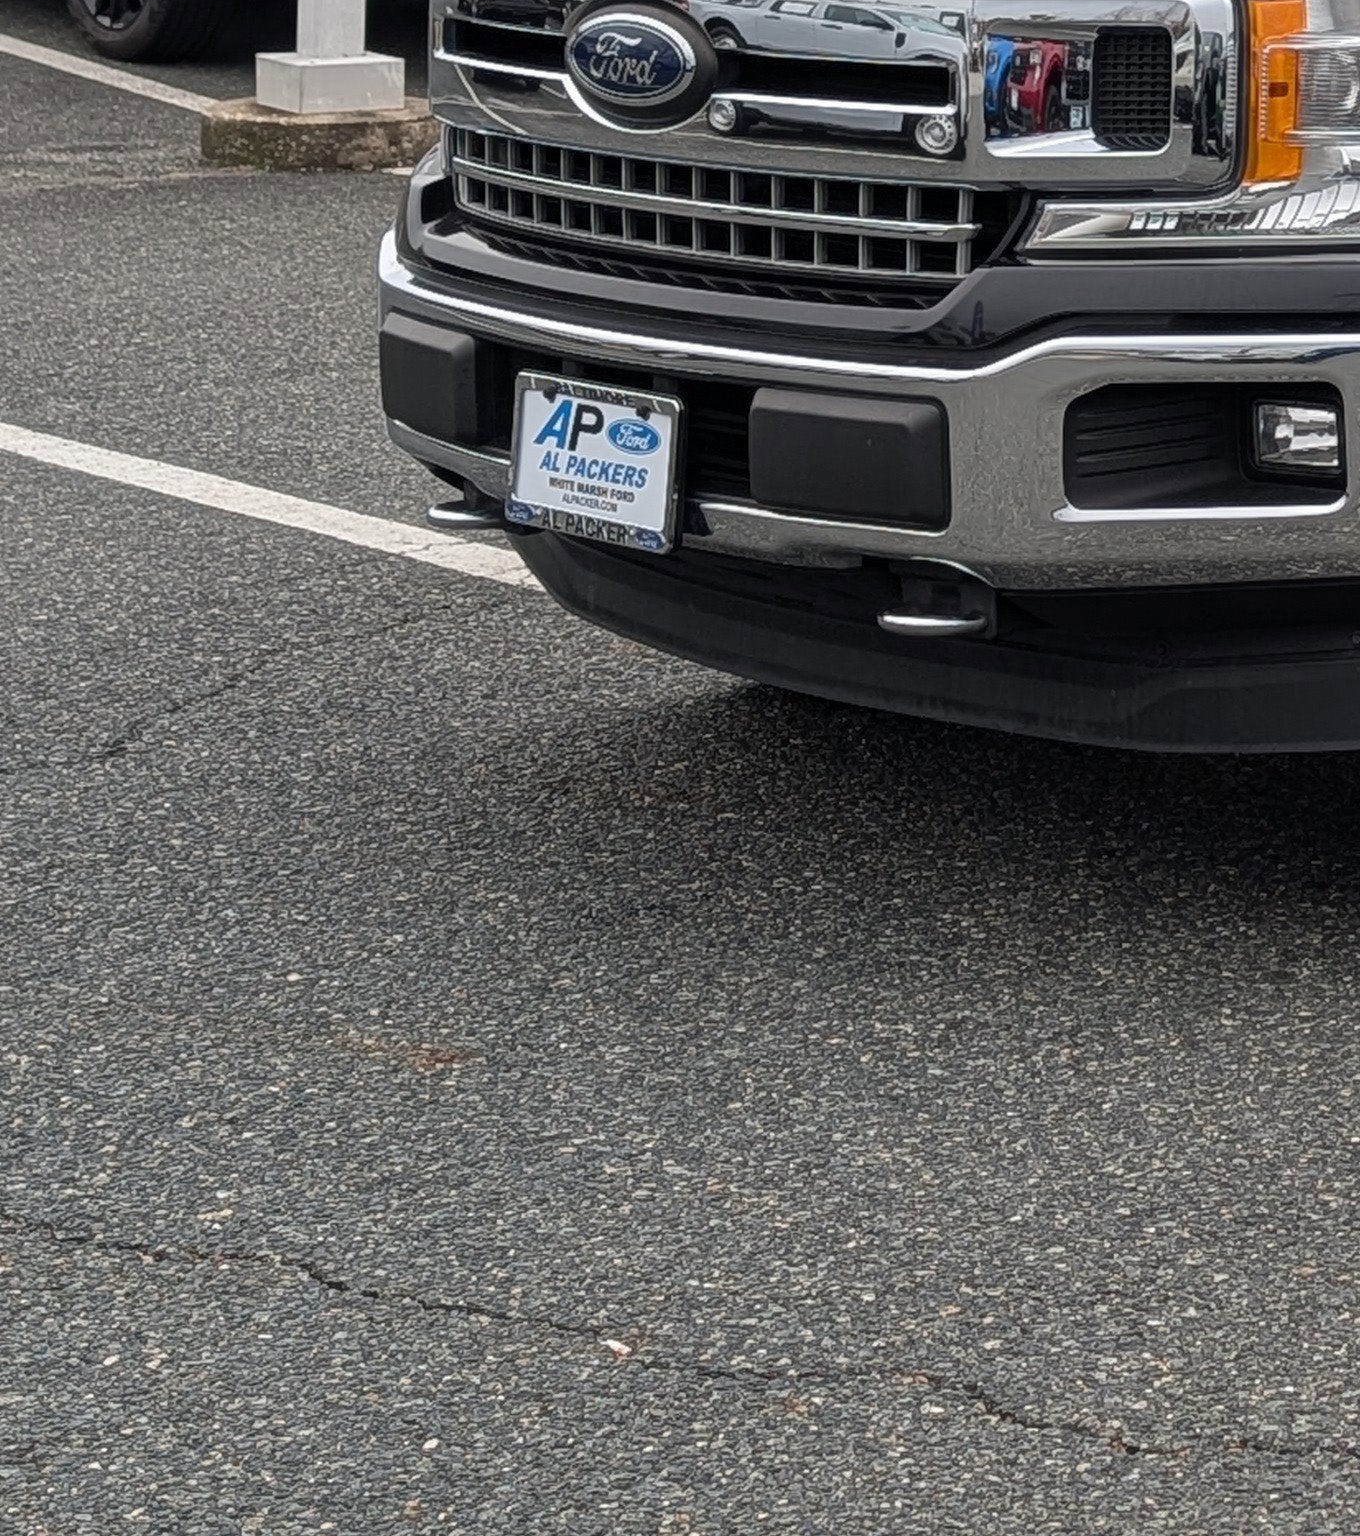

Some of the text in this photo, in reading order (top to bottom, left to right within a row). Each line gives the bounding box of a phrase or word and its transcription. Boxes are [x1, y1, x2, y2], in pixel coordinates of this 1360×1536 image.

[589, 31, 659, 86] Ford
[533, 399, 604, 451] AP
[615, 423, 652, 450] Ford
[539, 450, 649, 489] AL PACKERS
[548, 476, 636, 504] WHITE MARSH FORD
[542, 512, 629, 544] AL PACKER
